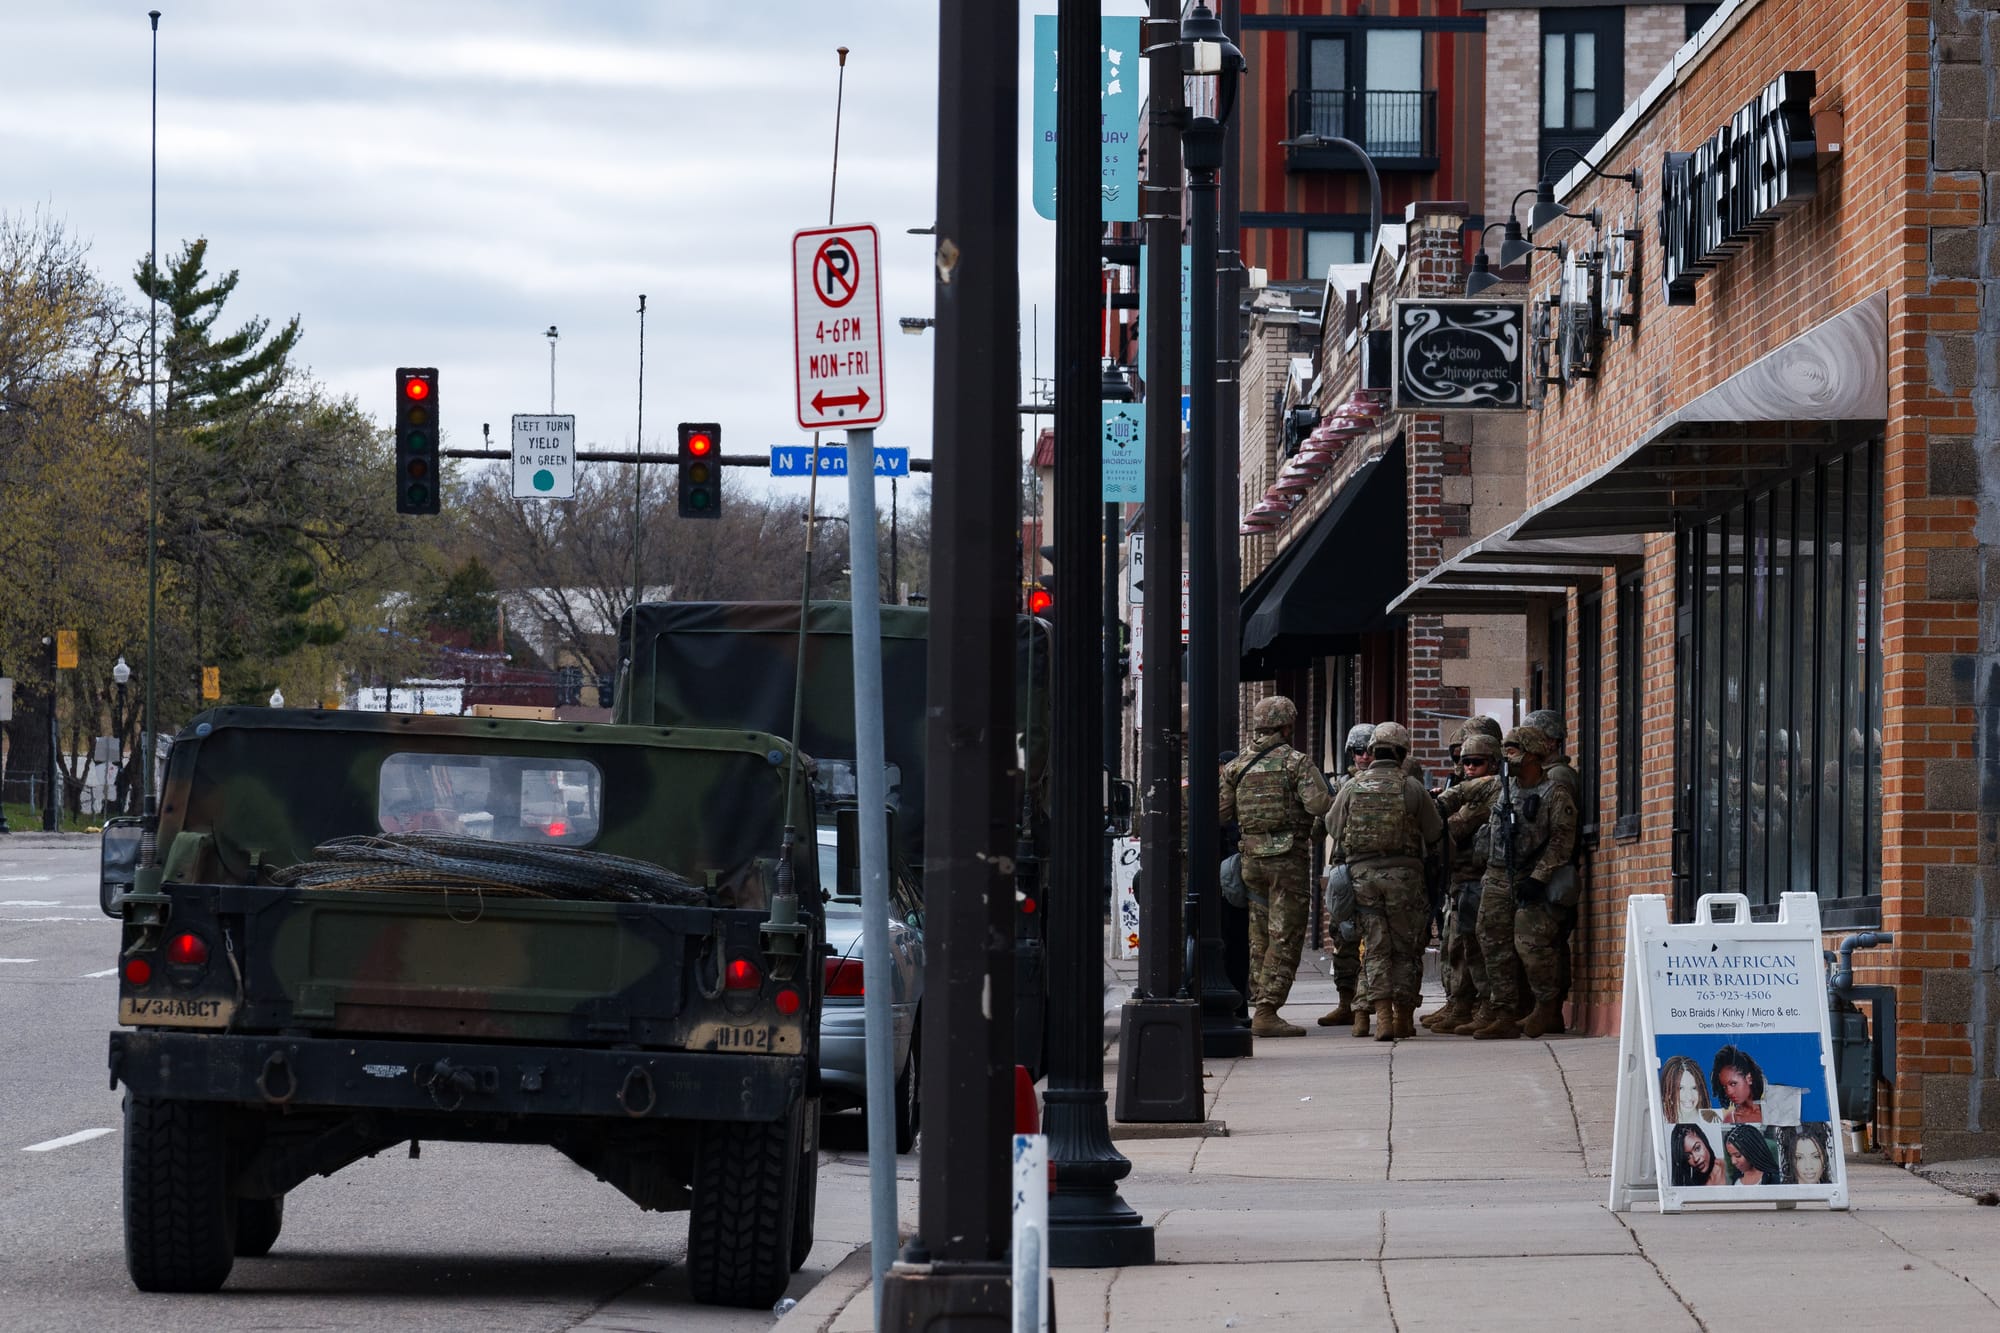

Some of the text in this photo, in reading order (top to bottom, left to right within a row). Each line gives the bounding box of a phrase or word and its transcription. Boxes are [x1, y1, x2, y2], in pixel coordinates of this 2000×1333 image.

[816, 317, 861, 343] 4-6PM
[1420, 341, 1481, 360] Watson
[810, 350, 869, 379] MON-FRI
[1422, 361, 1508, 380] Chiropractic
[518, 421, 570, 431] LEFT TURN
[529, 437, 559, 449] YIELD
[520, 455, 567, 466] ON GREEN
[779, 454, 793, 469] N
[874, 454, 899, 470] Av
[1668, 955, 1796, 969] HAWA AFRICAN
[1667, 972, 1799, 987] HAIR BRAIDING
[1696, 990, 1772, 1001] 763-923-4506
[1671, 1008, 1687, 1018] Box
[1689, 1007, 1716, 1018] Braids
[1722, 1007, 1745, 1019] Kinky
[1752, 1007, 1775, 1017] Micro
[1777, 1007, 1784, 1016] &
[1785, 1007, 1801, 1016] etc.
